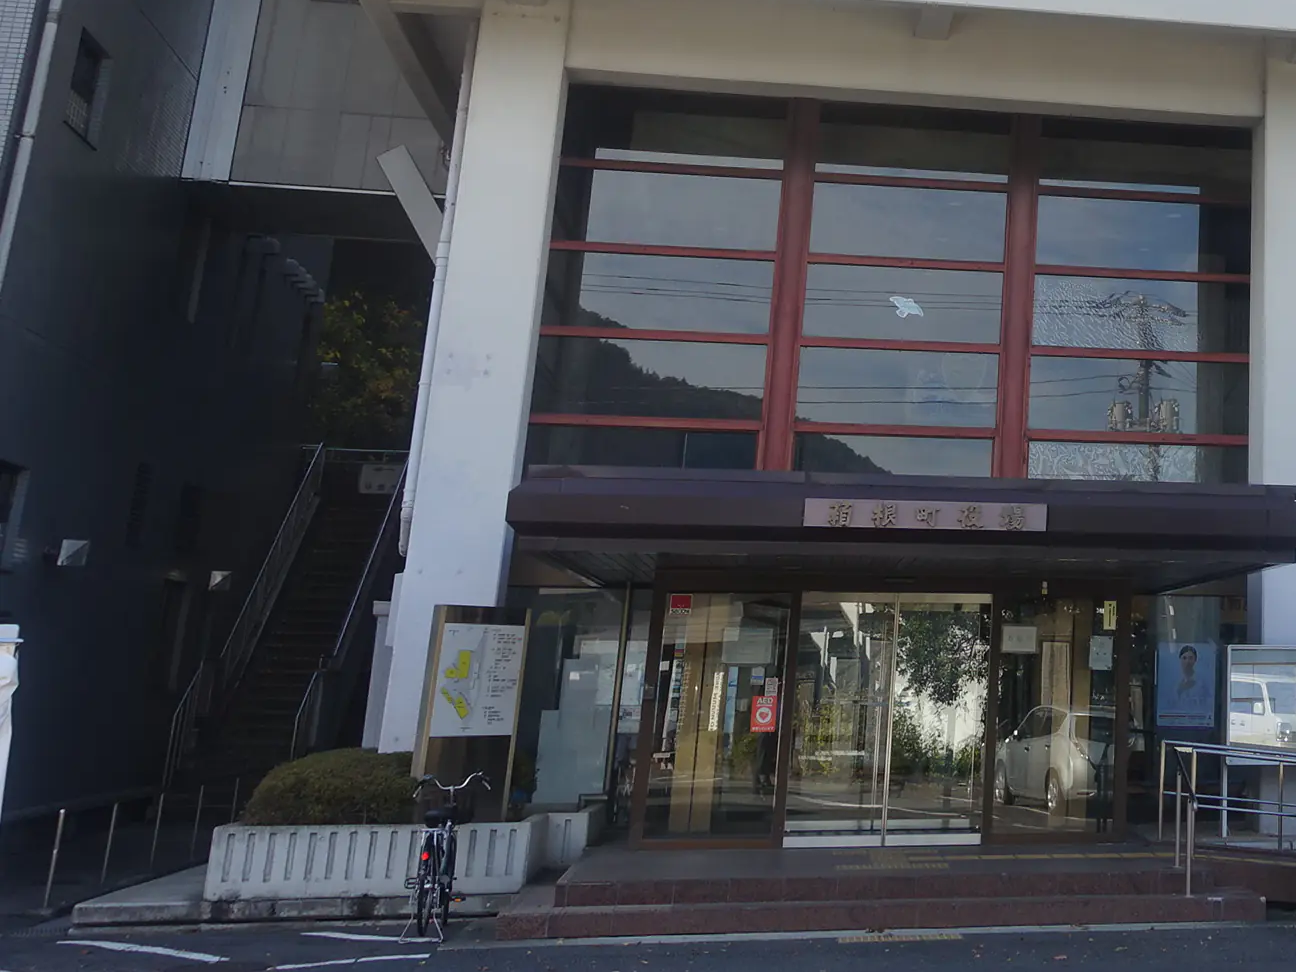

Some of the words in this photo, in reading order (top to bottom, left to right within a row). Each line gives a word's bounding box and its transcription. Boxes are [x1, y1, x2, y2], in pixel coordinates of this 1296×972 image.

[827, 502, 1026, 531] 箱根町役場
[756, 697, 774, 705] AED
